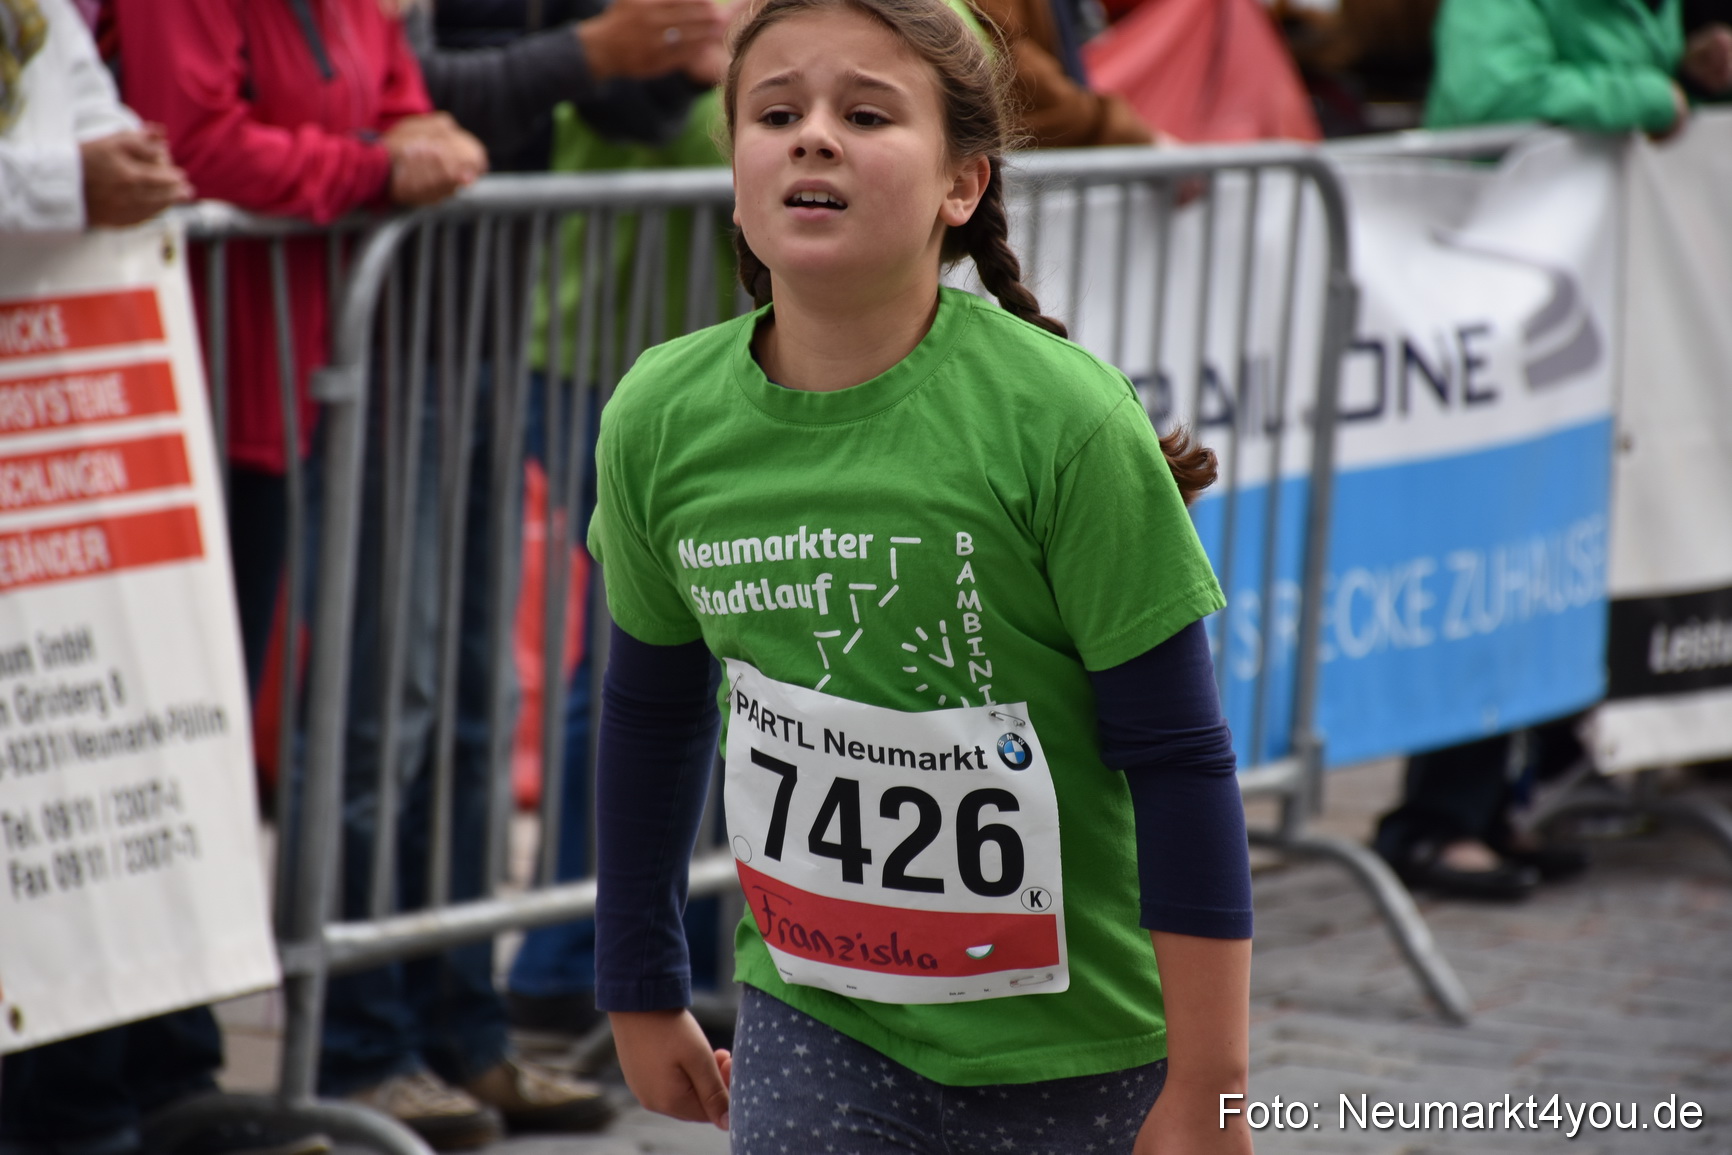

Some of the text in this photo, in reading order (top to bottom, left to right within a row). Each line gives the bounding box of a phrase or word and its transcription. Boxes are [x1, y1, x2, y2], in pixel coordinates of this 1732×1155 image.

[678, 525, 874, 569] Neumarkter
[691, 573, 833, 616] Stadtlauf
[955, 531, 996, 707] BAMBINI
[736, 690, 988, 771] PARTL Neumarkt
[998, 733, 1025, 748] BMW
[750, 747, 1025, 898] 7426
[1030, 890, 1043, 908] K
